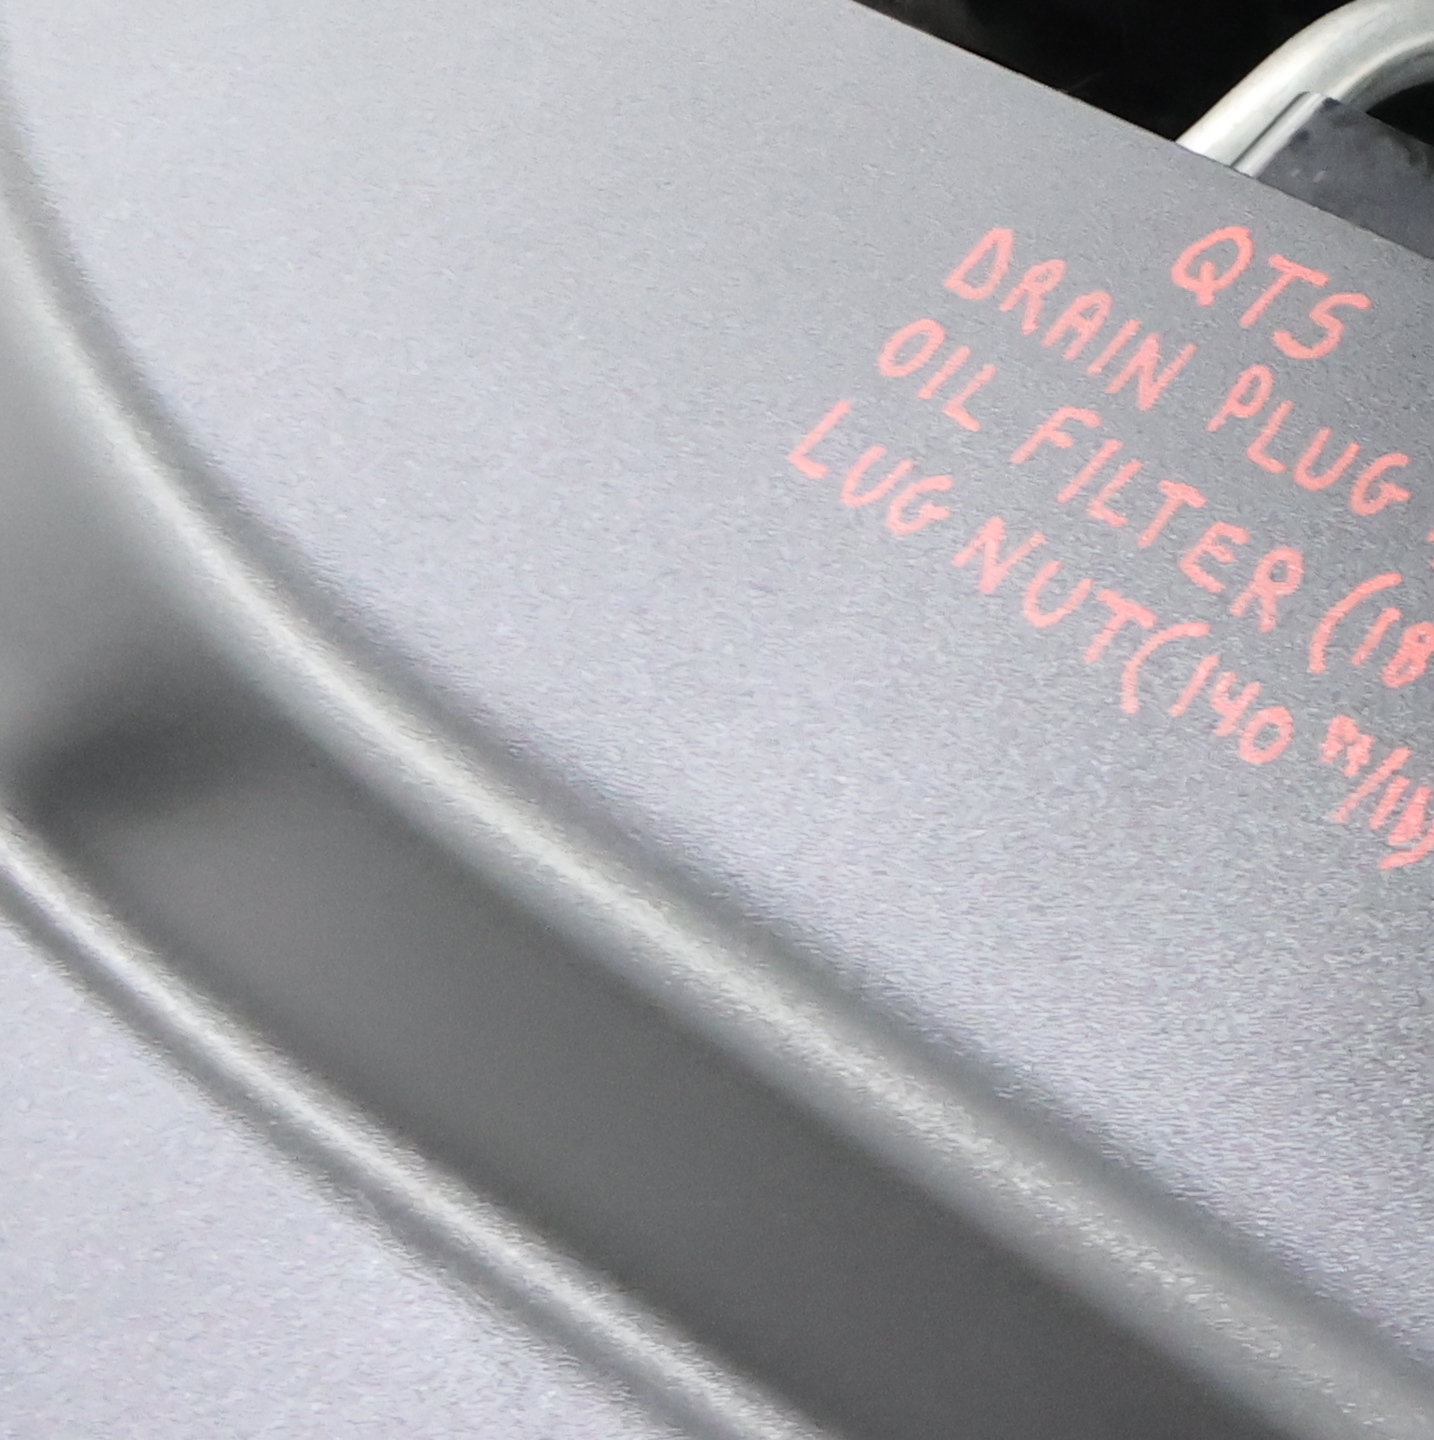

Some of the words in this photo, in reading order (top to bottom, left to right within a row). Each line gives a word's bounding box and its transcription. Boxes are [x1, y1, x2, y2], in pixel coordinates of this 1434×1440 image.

[944, 226, 1197, 410] DRAIN
[1208, 364, 1411, 515] PLUG
[1172, 226, 1371, 358] QTS
[789, 400, 952, 534] LUG
[880, 318, 995, 431] OIL
[1013, 406, 1305, 631] FILTER
